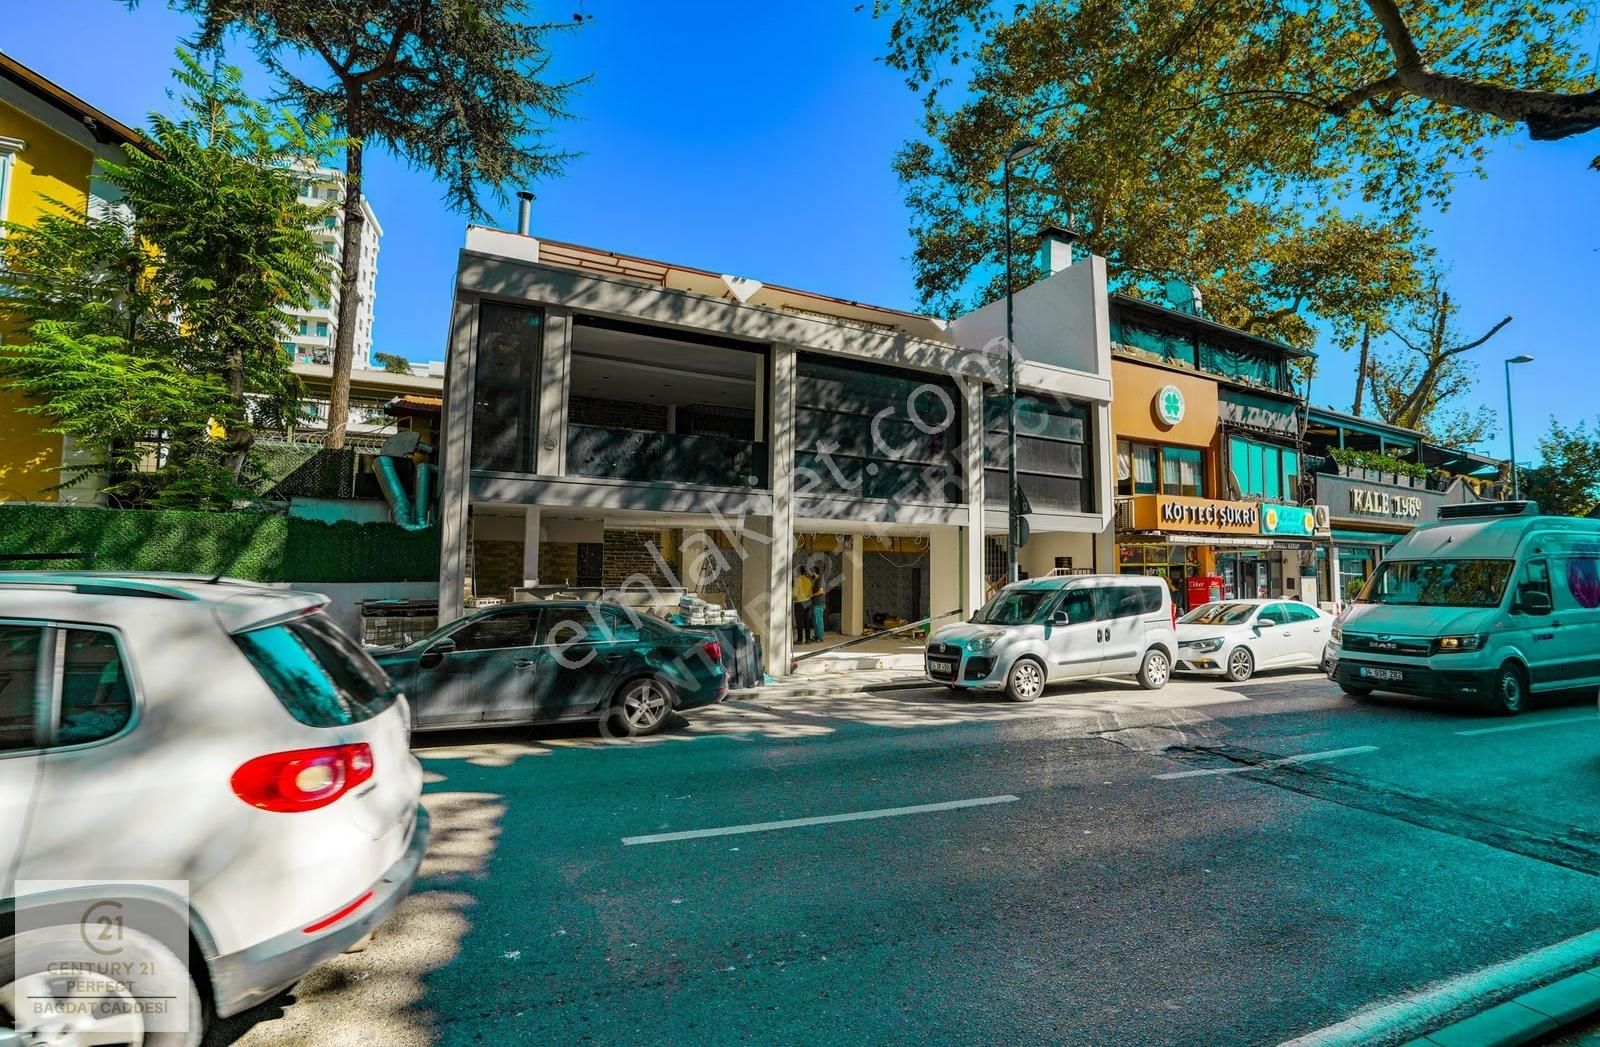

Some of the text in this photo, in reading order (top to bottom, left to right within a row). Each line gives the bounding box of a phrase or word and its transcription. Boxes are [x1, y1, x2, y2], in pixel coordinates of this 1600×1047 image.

[1164, 502, 1216, 522] KÖFTECİ
[1220, 504, 1257, 526] ŞÜKRÜ
[1352, 488, 1422, 517] KALE 1969
